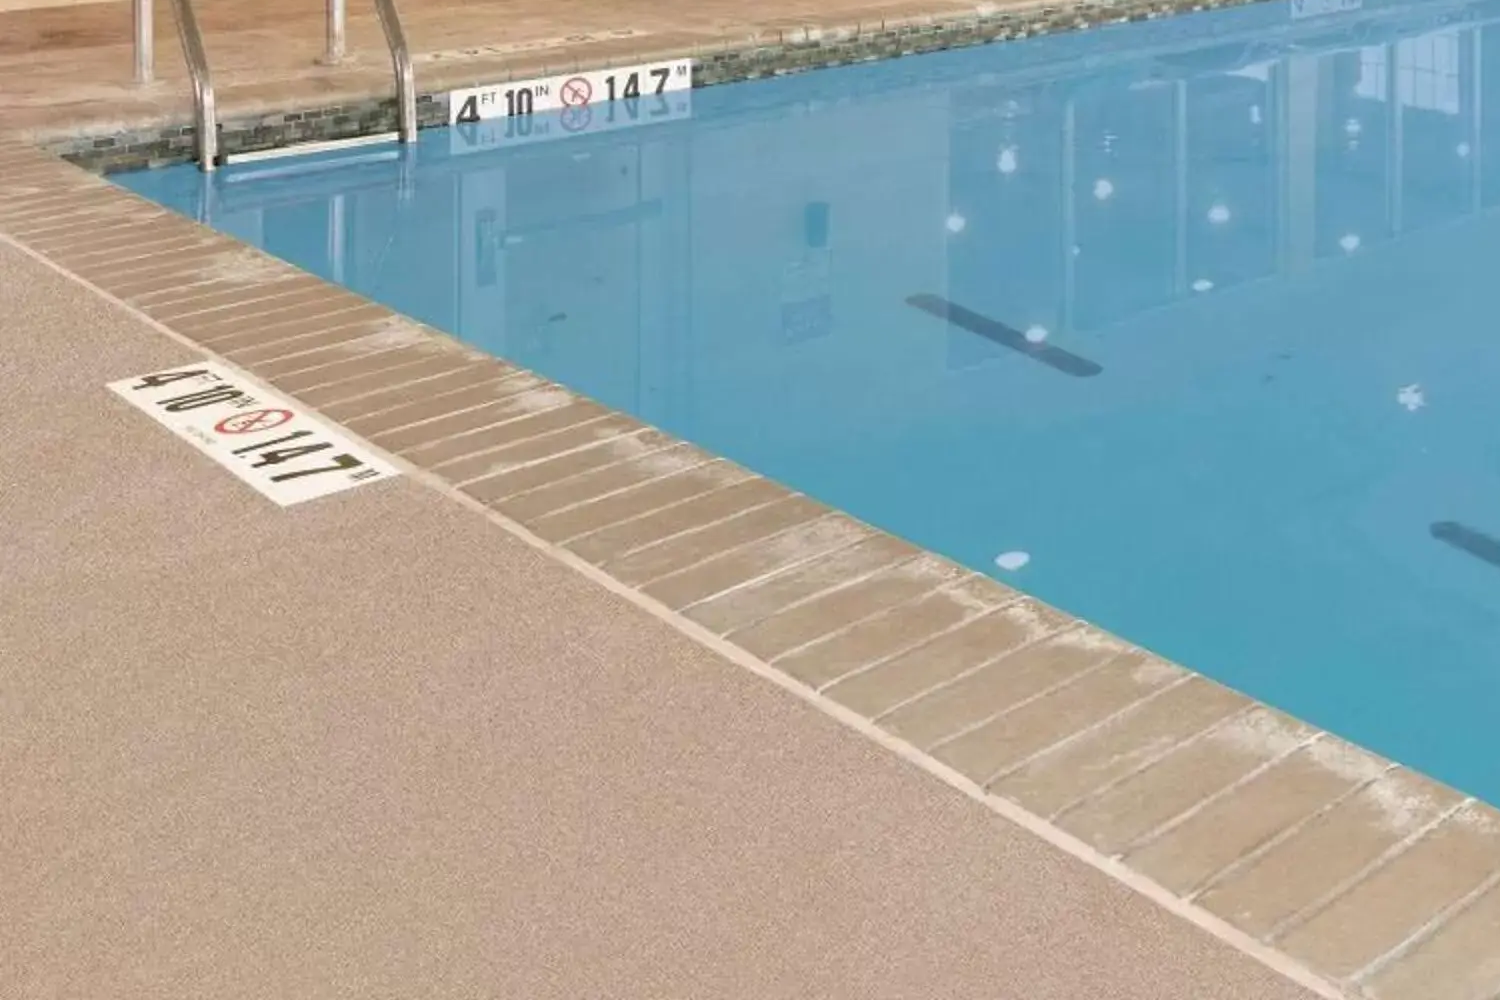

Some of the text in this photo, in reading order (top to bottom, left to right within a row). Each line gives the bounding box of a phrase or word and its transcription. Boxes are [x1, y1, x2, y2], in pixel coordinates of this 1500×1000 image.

[456, 95, 481, 124] 4
[481, 92, 497, 105] FT
[505, 87, 533, 116] 10
[535, 84, 550, 97] IN
[132, 369, 208, 390] 4
[156, 385, 244, 412] 10
